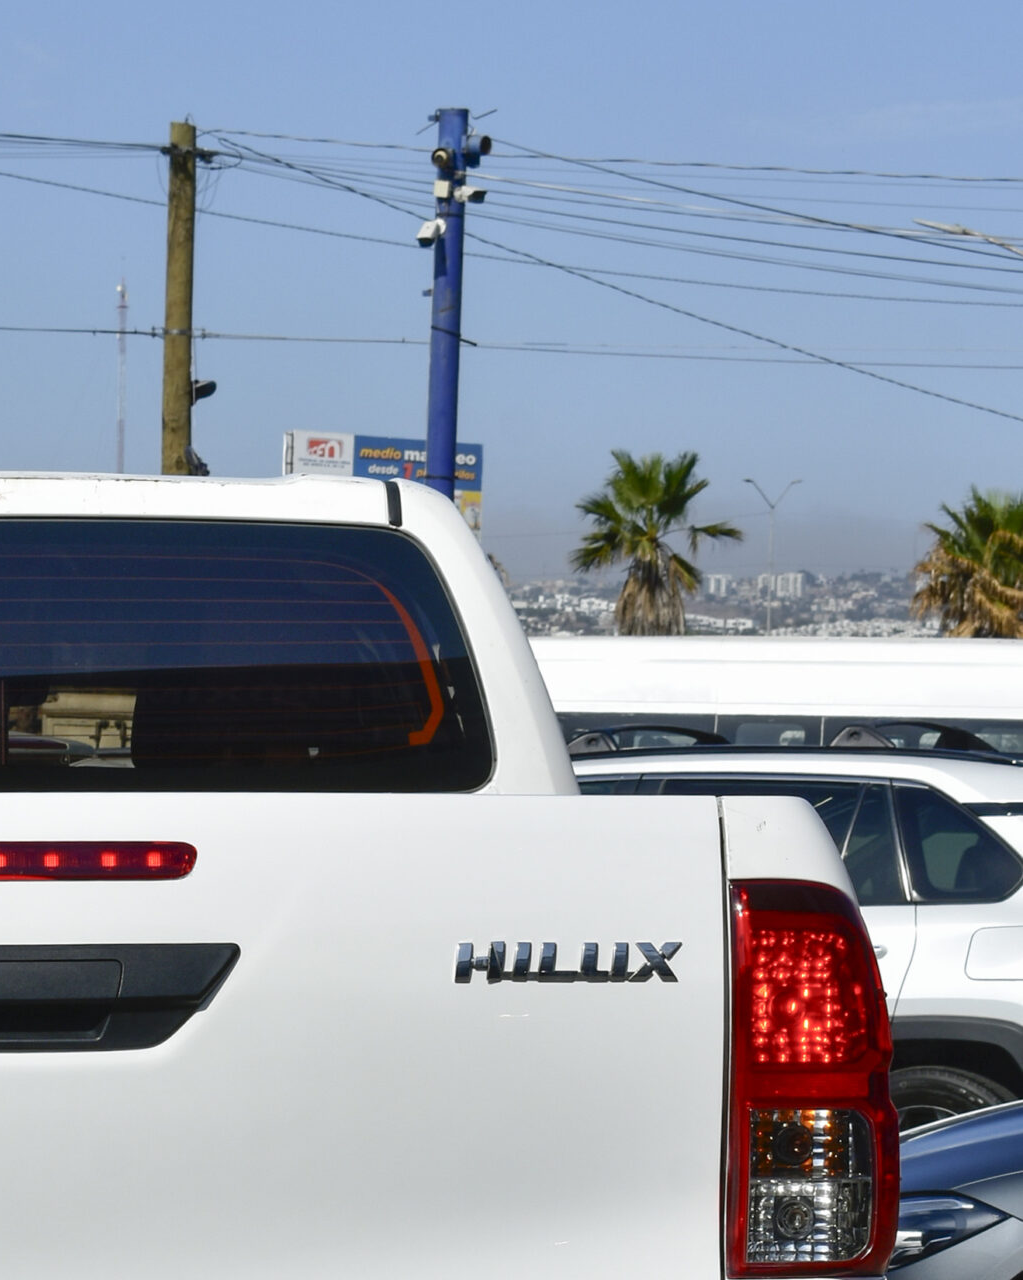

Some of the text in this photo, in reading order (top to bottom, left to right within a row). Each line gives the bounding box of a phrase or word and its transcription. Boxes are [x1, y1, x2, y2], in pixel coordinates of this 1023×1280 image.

[359, 447, 477, 466] medio maeo
[368, 463, 399, 475] desde
[403, 462, 414, 480] 1
[454, 940, 683, 984] HILUX
